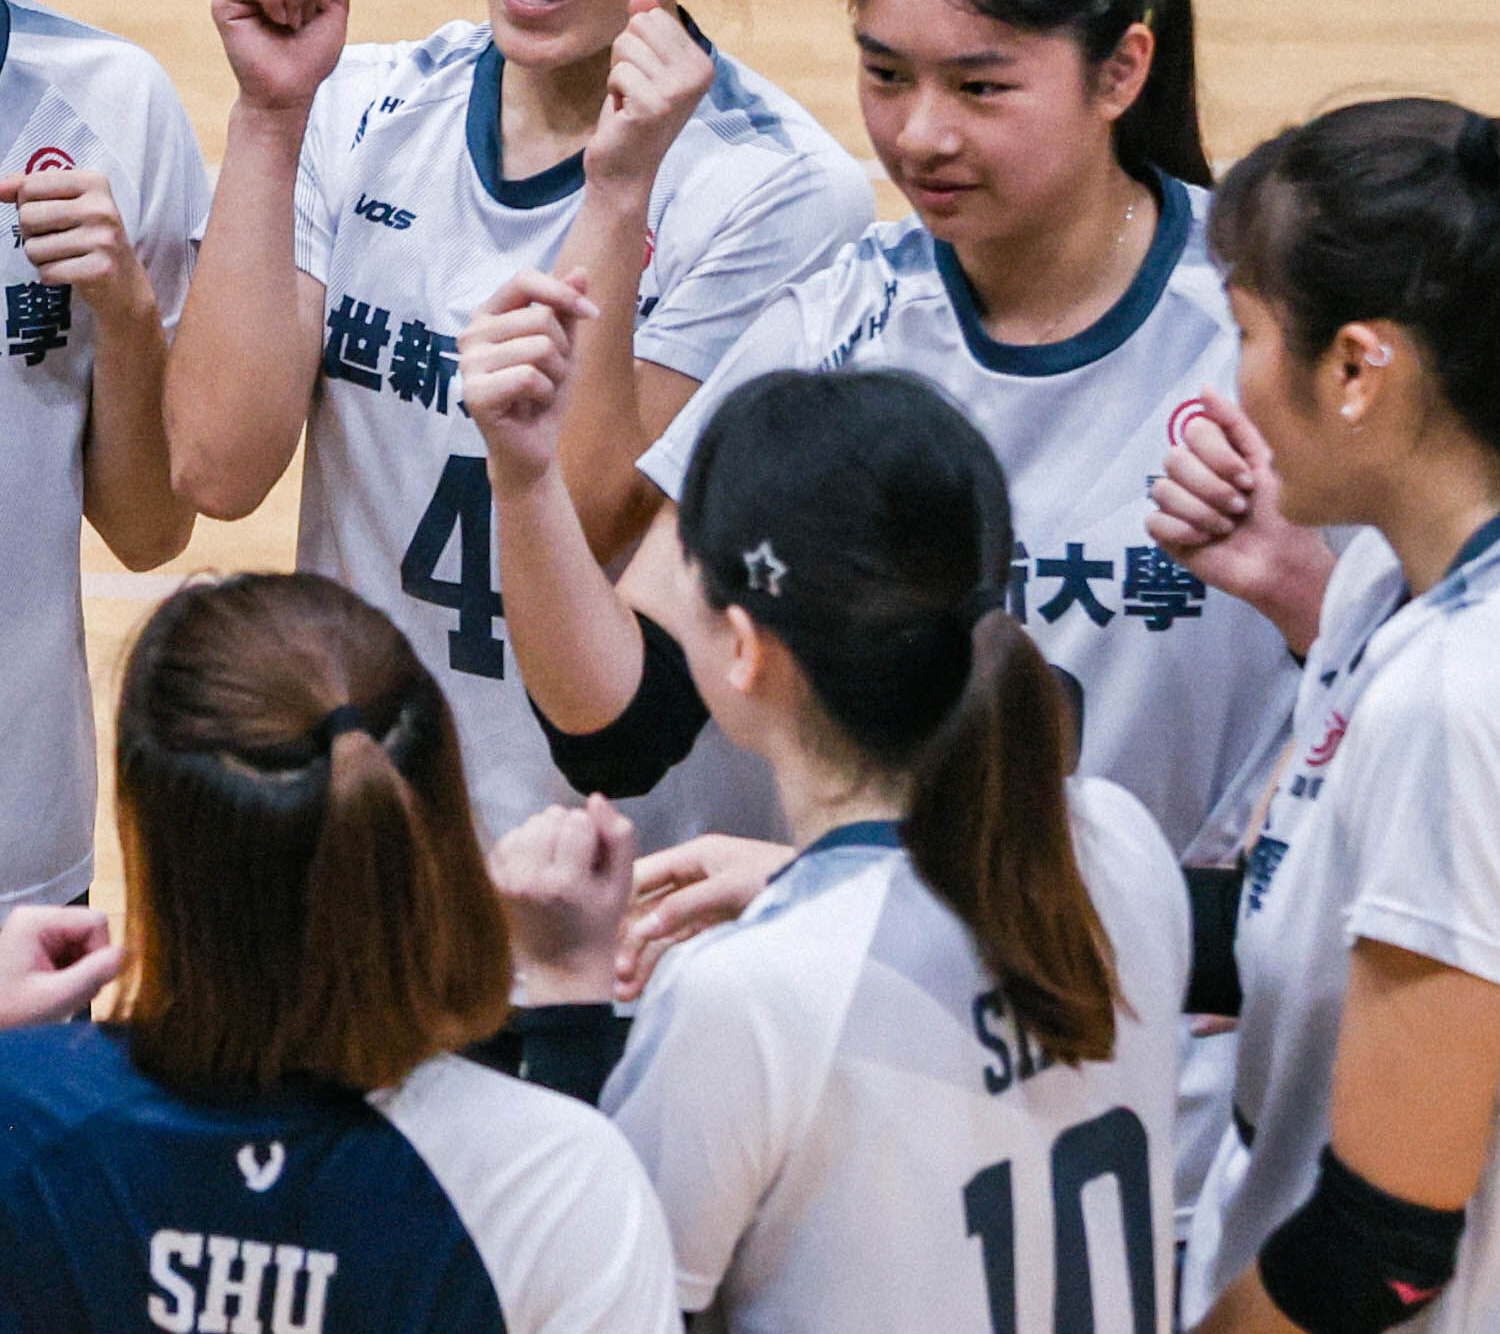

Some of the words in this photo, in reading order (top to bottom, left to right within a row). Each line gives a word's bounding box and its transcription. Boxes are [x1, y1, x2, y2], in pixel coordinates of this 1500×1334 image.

[354, 192, 417, 230] VOLS
[401, 454, 505, 680] 4
[1008, 541, 1206, 631] 大學
